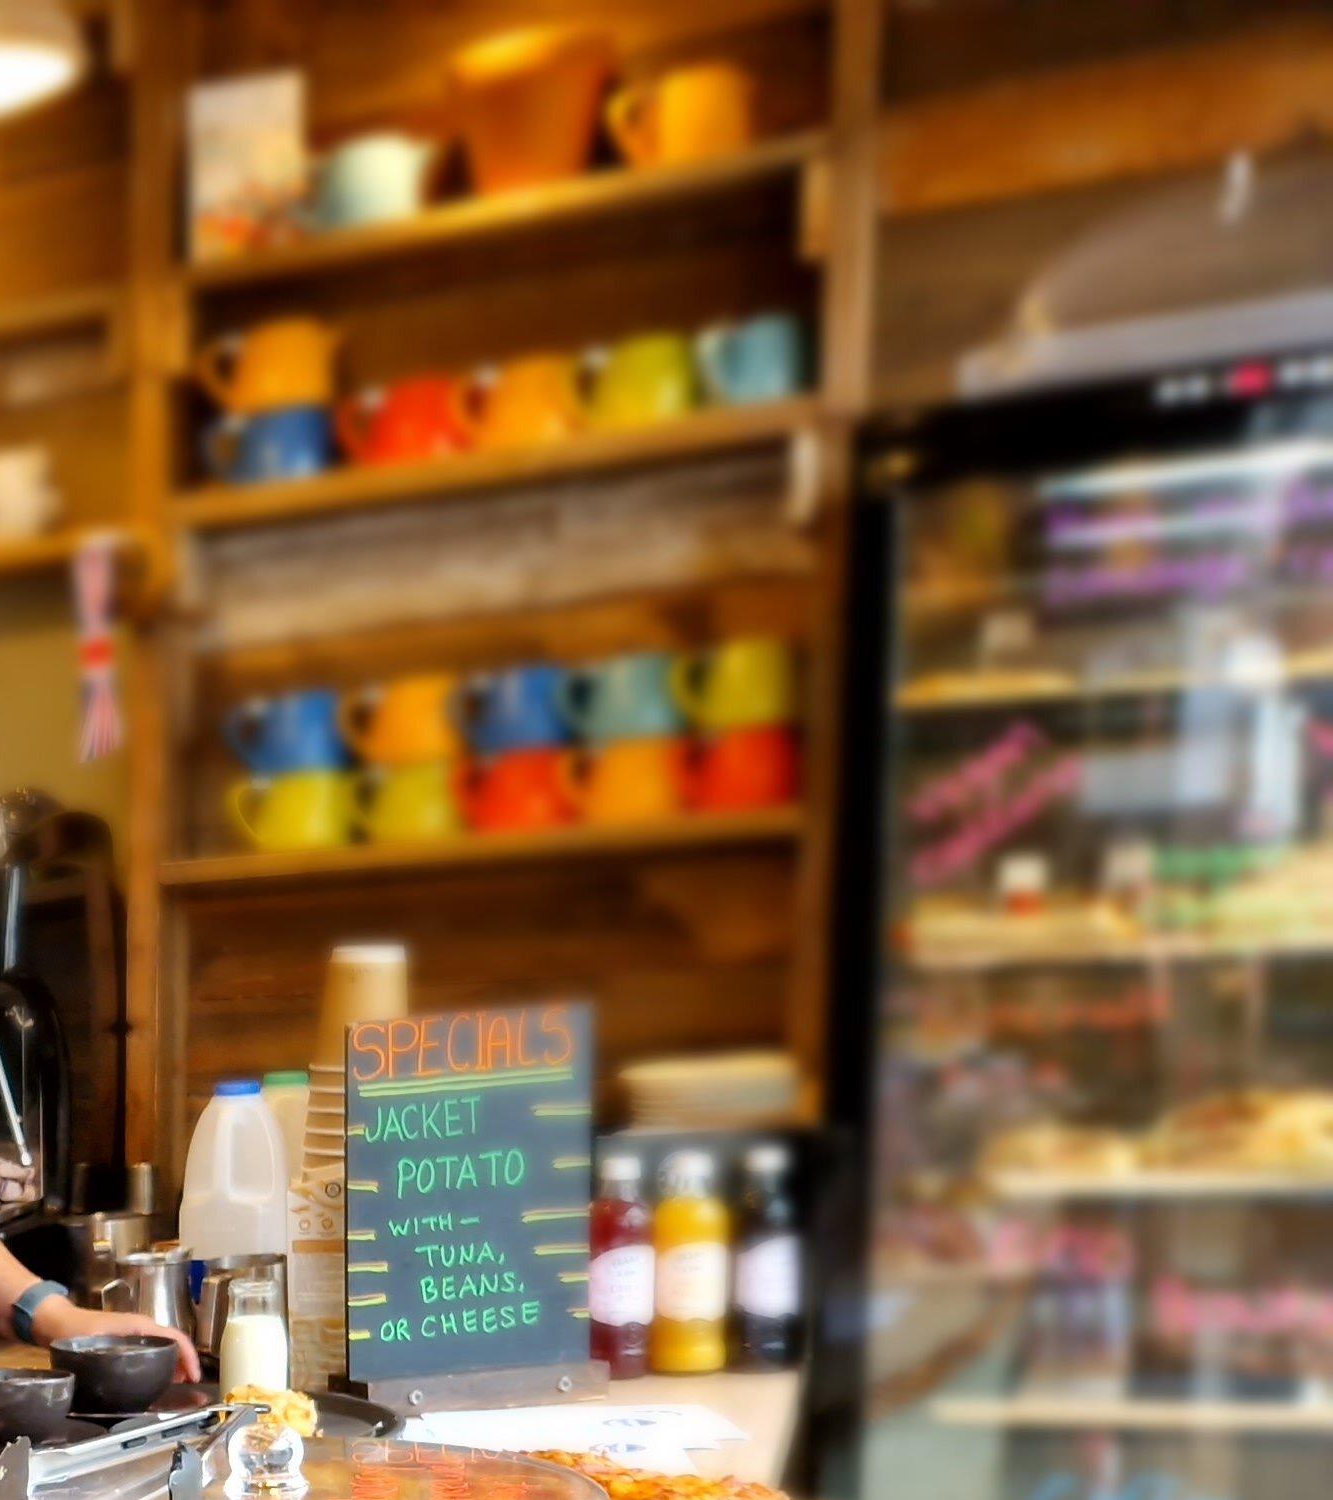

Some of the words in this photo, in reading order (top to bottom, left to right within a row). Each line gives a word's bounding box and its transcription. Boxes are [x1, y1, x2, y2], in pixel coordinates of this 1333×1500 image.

[353, 1010, 572, 1081] SPECIALS
[365, 1096, 482, 1144] JACKET
[397, 1148, 526, 1199] POTATO
[380, 1318, 412, 1343] OR
[421, 1301, 541, 1339] CHEESE
